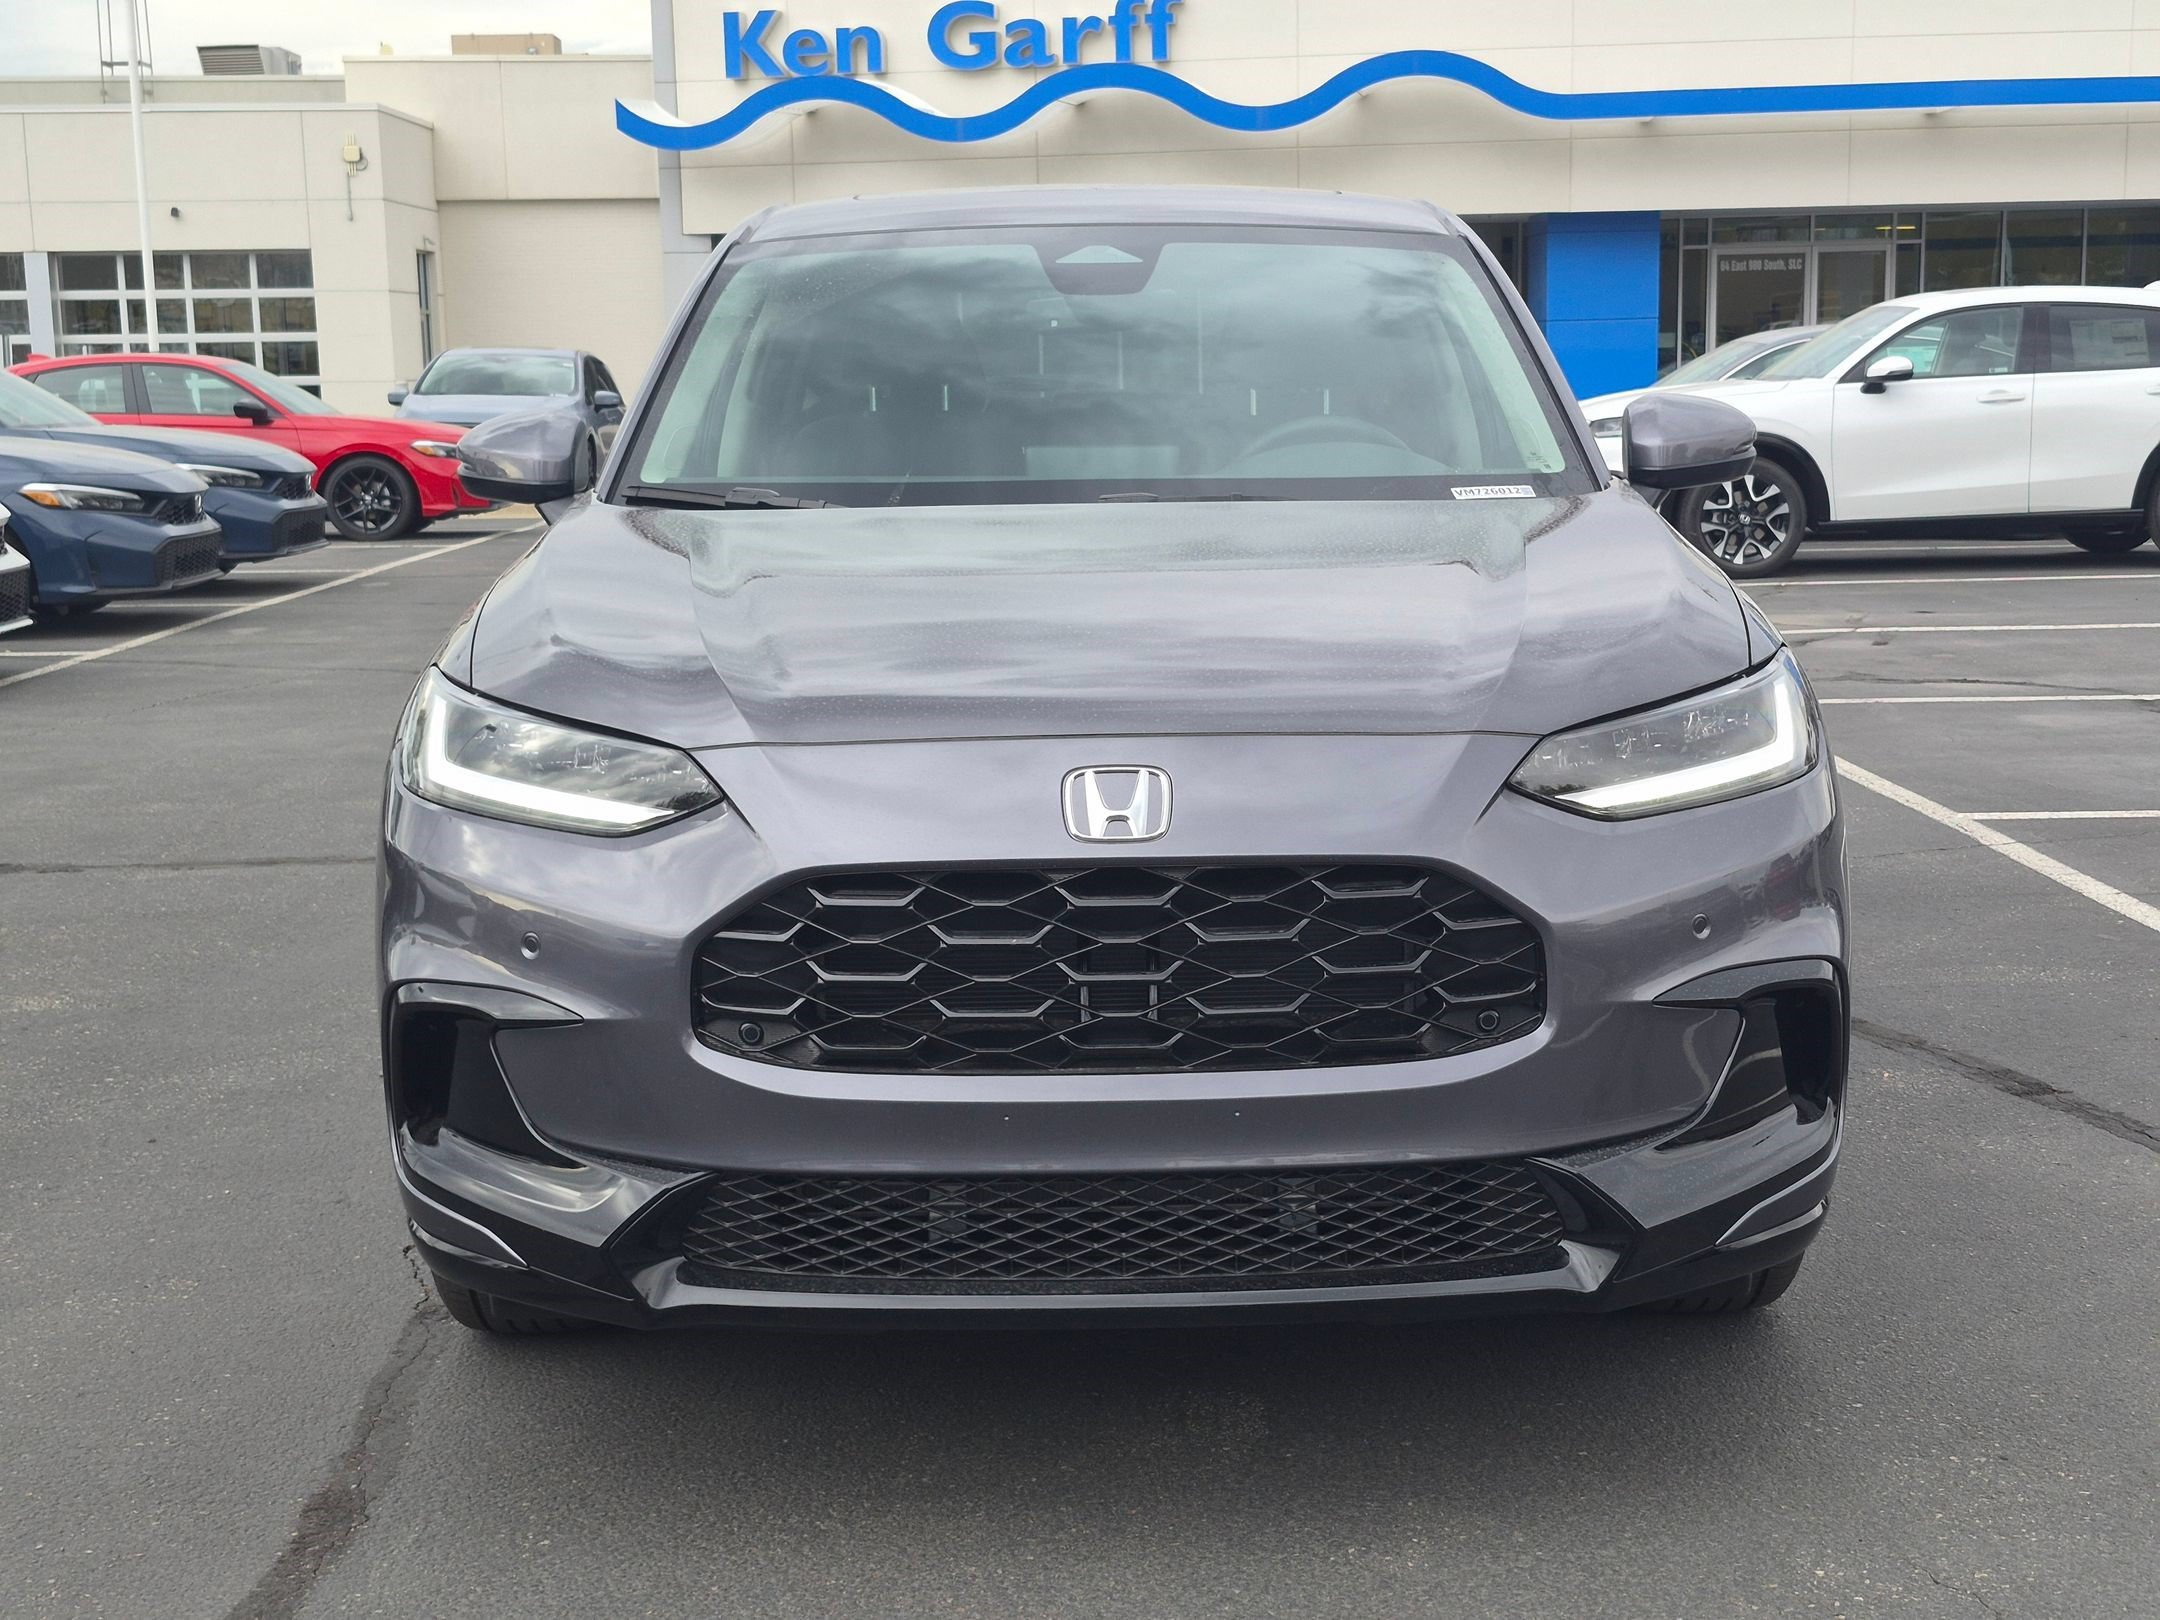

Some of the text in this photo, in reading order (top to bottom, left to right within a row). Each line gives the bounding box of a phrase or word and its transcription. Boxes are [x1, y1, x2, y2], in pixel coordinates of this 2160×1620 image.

[722, 0, 1183, 79] Ken Garff
[1720, 260, 1730, 272] 64
[1731, 260, 1747, 272] East
[1788, 258, 1802, 270] SLC
